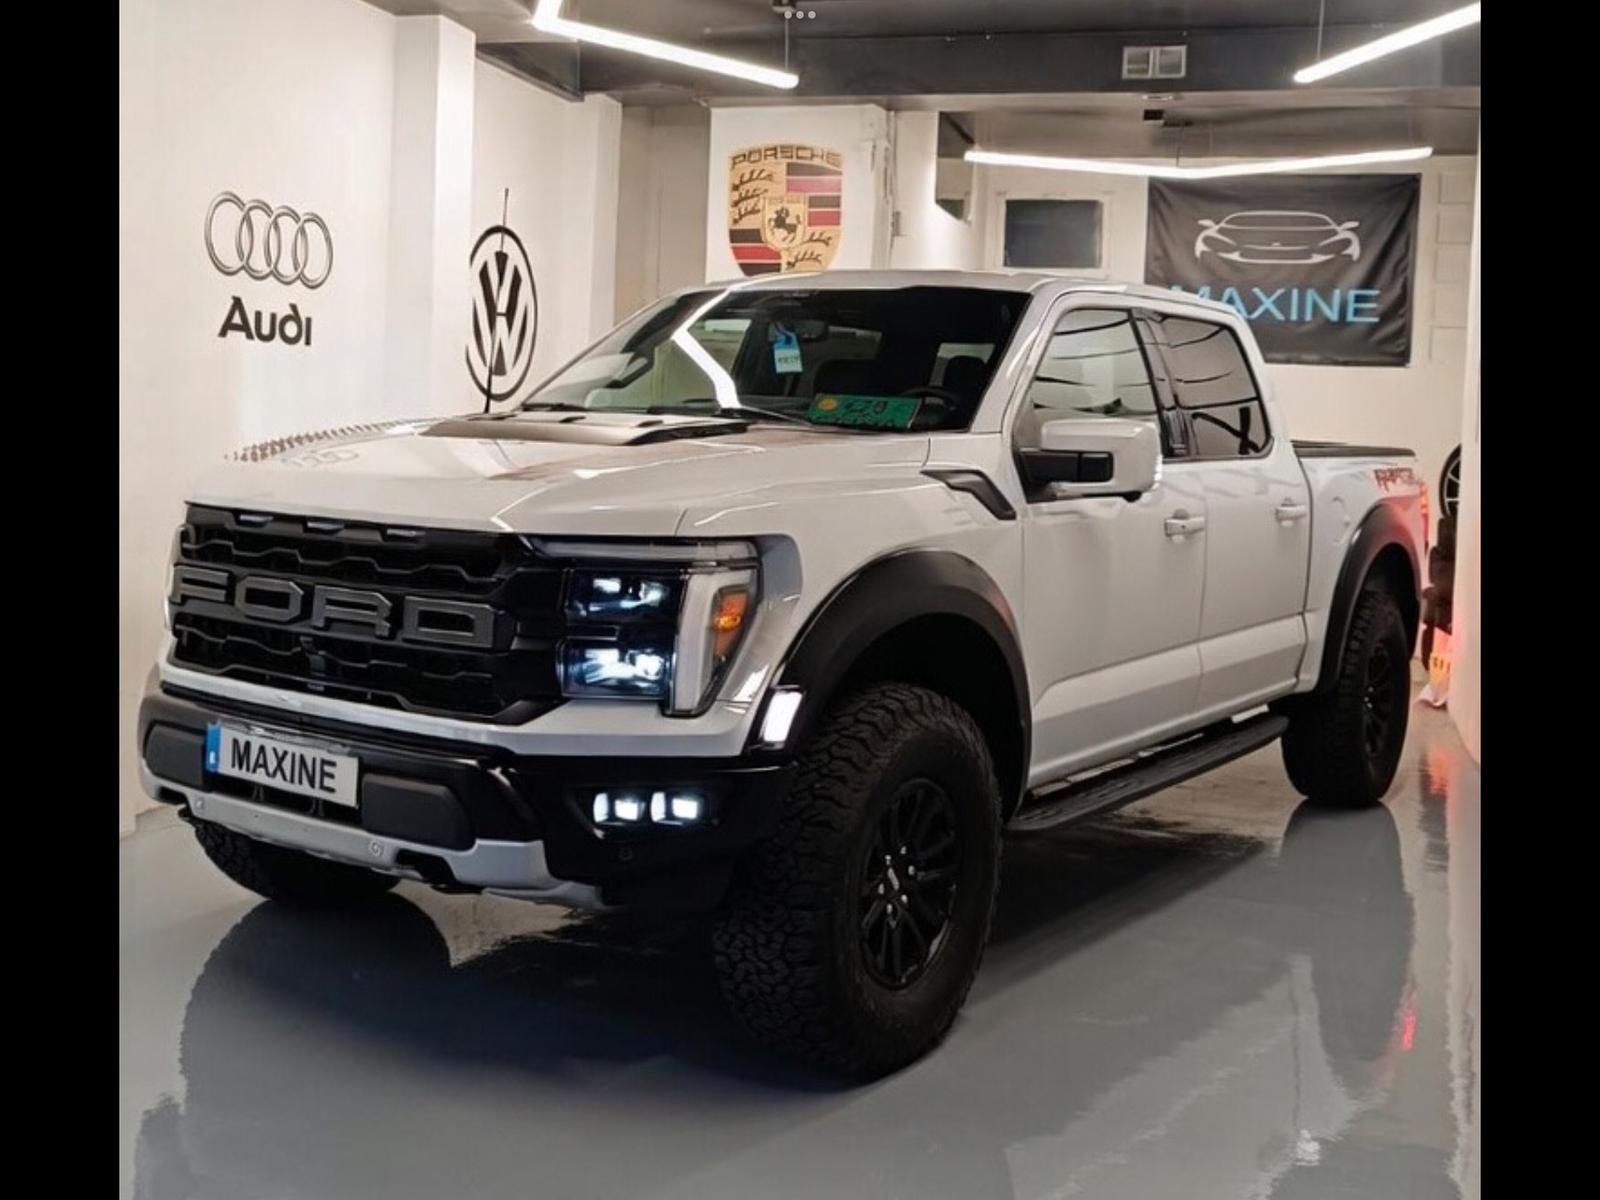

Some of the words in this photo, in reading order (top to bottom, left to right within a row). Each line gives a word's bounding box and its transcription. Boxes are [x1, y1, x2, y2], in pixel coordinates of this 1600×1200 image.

[730, 144, 842, 170] PORSCHE
[218, 295, 312, 346] Audi
[168, 563, 494, 649] FORD
[231, 737, 338, 794] MAXINE
